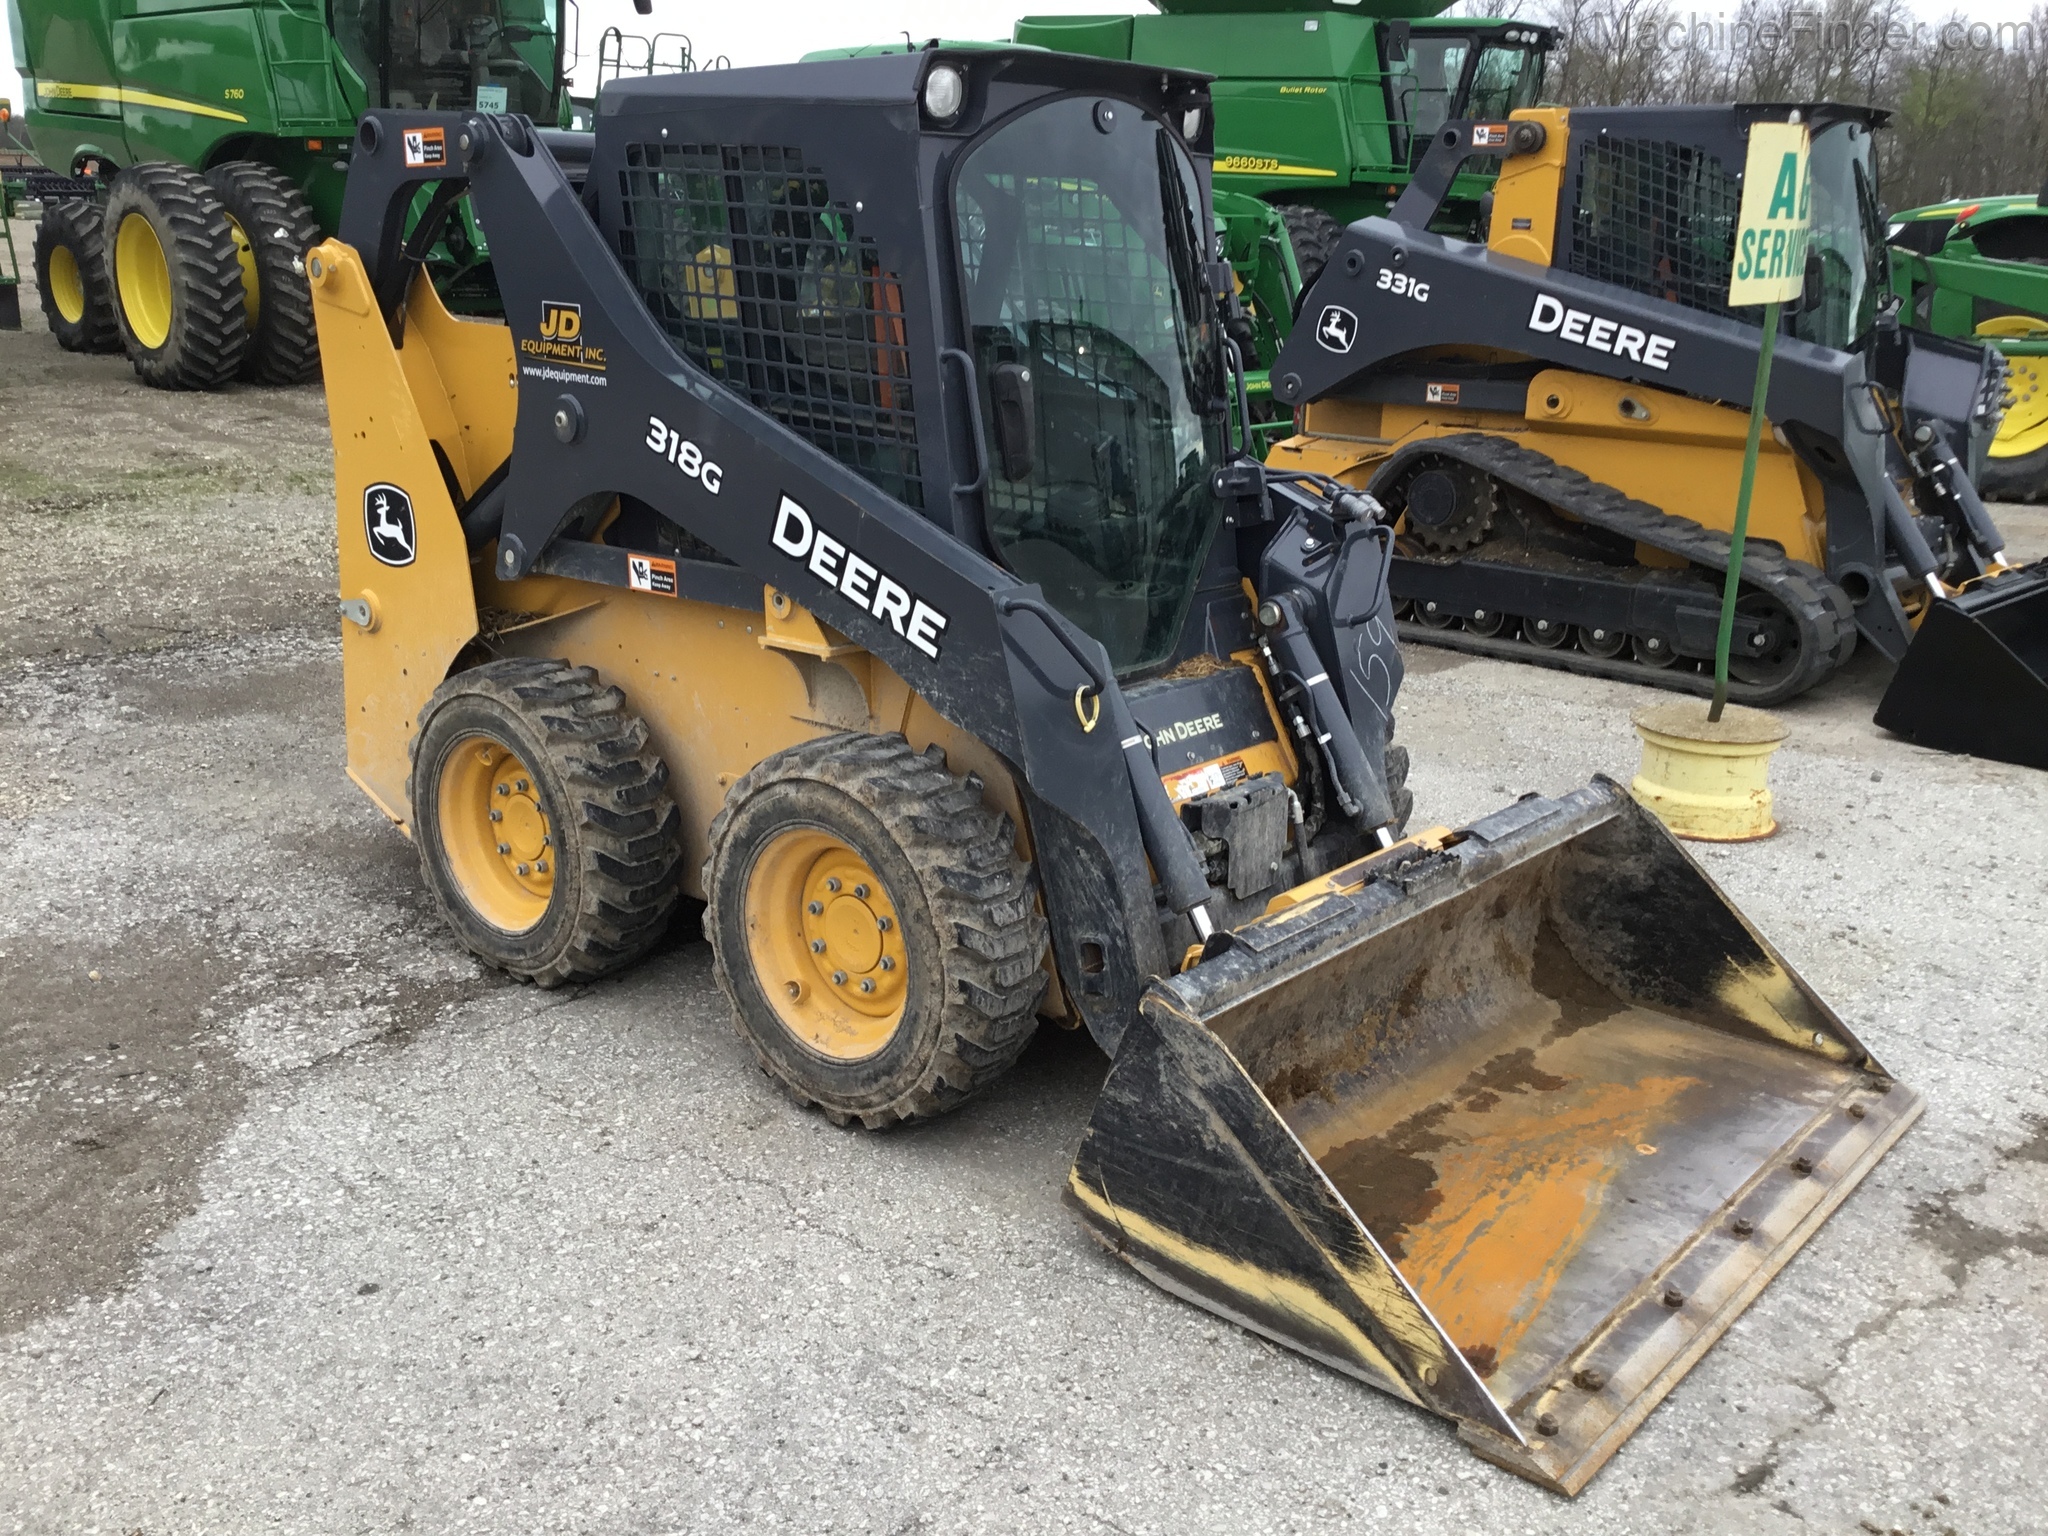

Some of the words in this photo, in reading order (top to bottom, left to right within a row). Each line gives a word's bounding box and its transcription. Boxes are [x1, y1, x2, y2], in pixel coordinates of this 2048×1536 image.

[56, 85, 73, 98] DEERE
[224, 88, 244, 99] S760
[1225, 156, 1278, 170] 9660STS
[1376, 268, 1430, 302] 331G
[540, 309, 581, 340] JD
[1528, 293, 1676, 370] DEERE
[521, 339, 582, 358] EQUIPMENT
[585, 347, 606, 362] INC.
[522, 366, 607, 386] www.jdequipment.com
[646, 416, 723, 494] 318G
[772, 495, 947, 659] DEERE
[1174, 713, 1223, 740] DEERE
